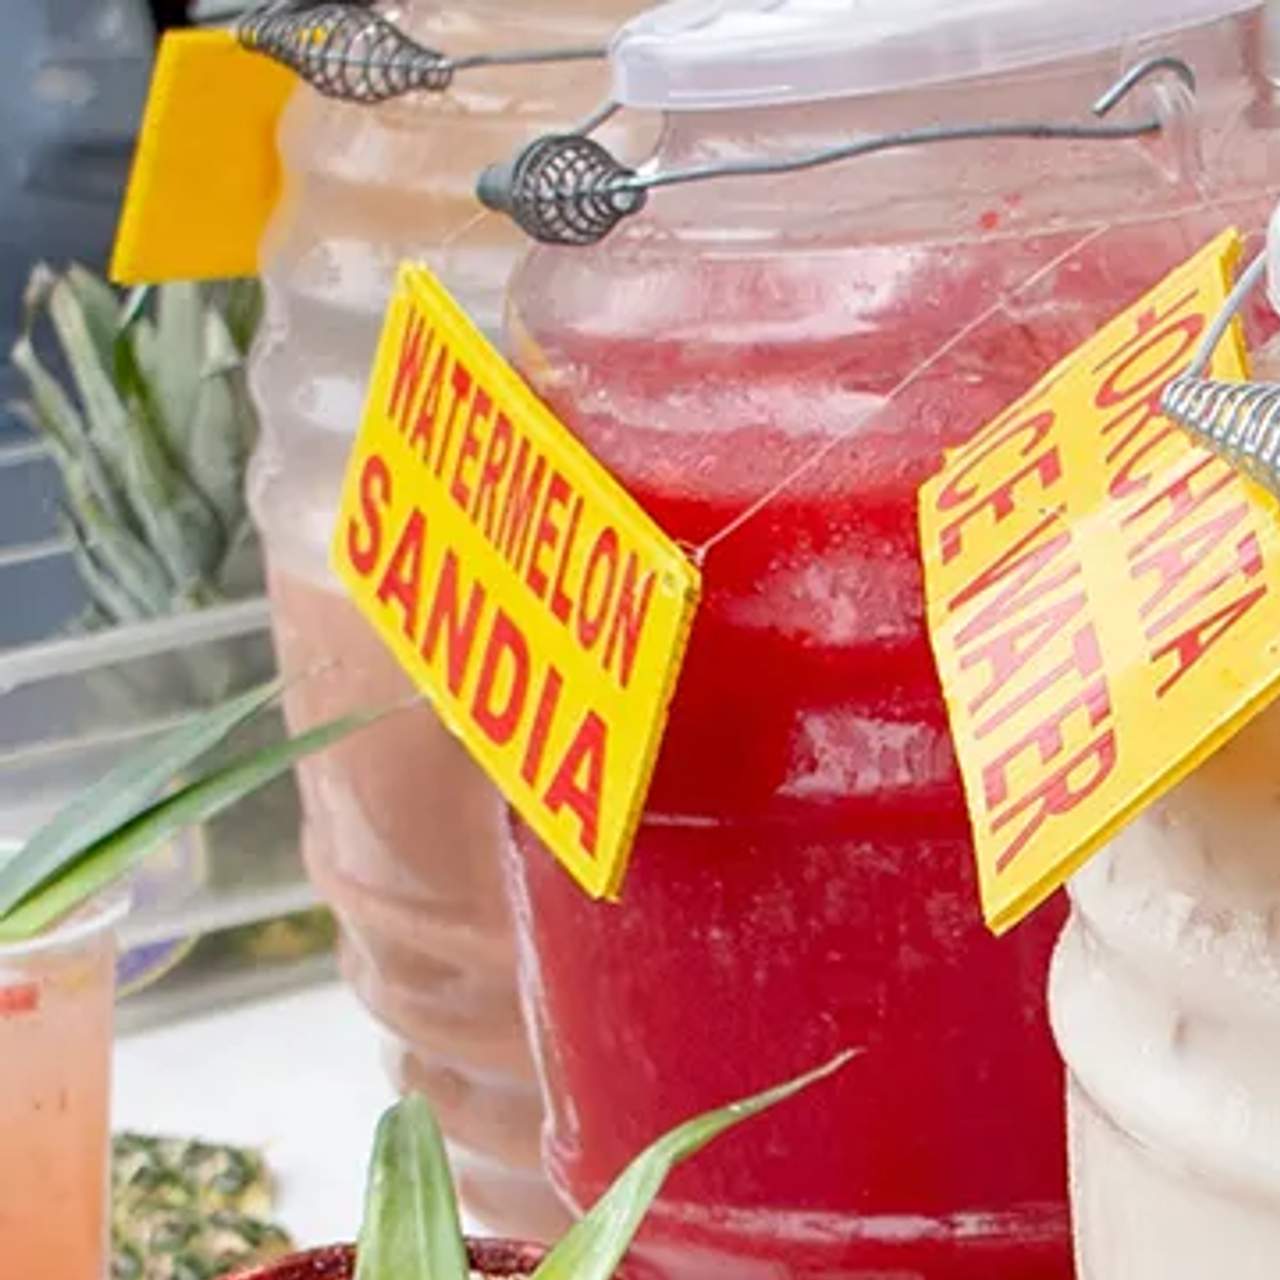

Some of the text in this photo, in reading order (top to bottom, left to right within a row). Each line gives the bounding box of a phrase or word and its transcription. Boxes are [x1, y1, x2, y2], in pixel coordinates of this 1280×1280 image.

[347, 454, 610, 860] SANDIA
[388, 307, 657, 689] WATERMELON
[948, 503, 1118, 875] WATER
